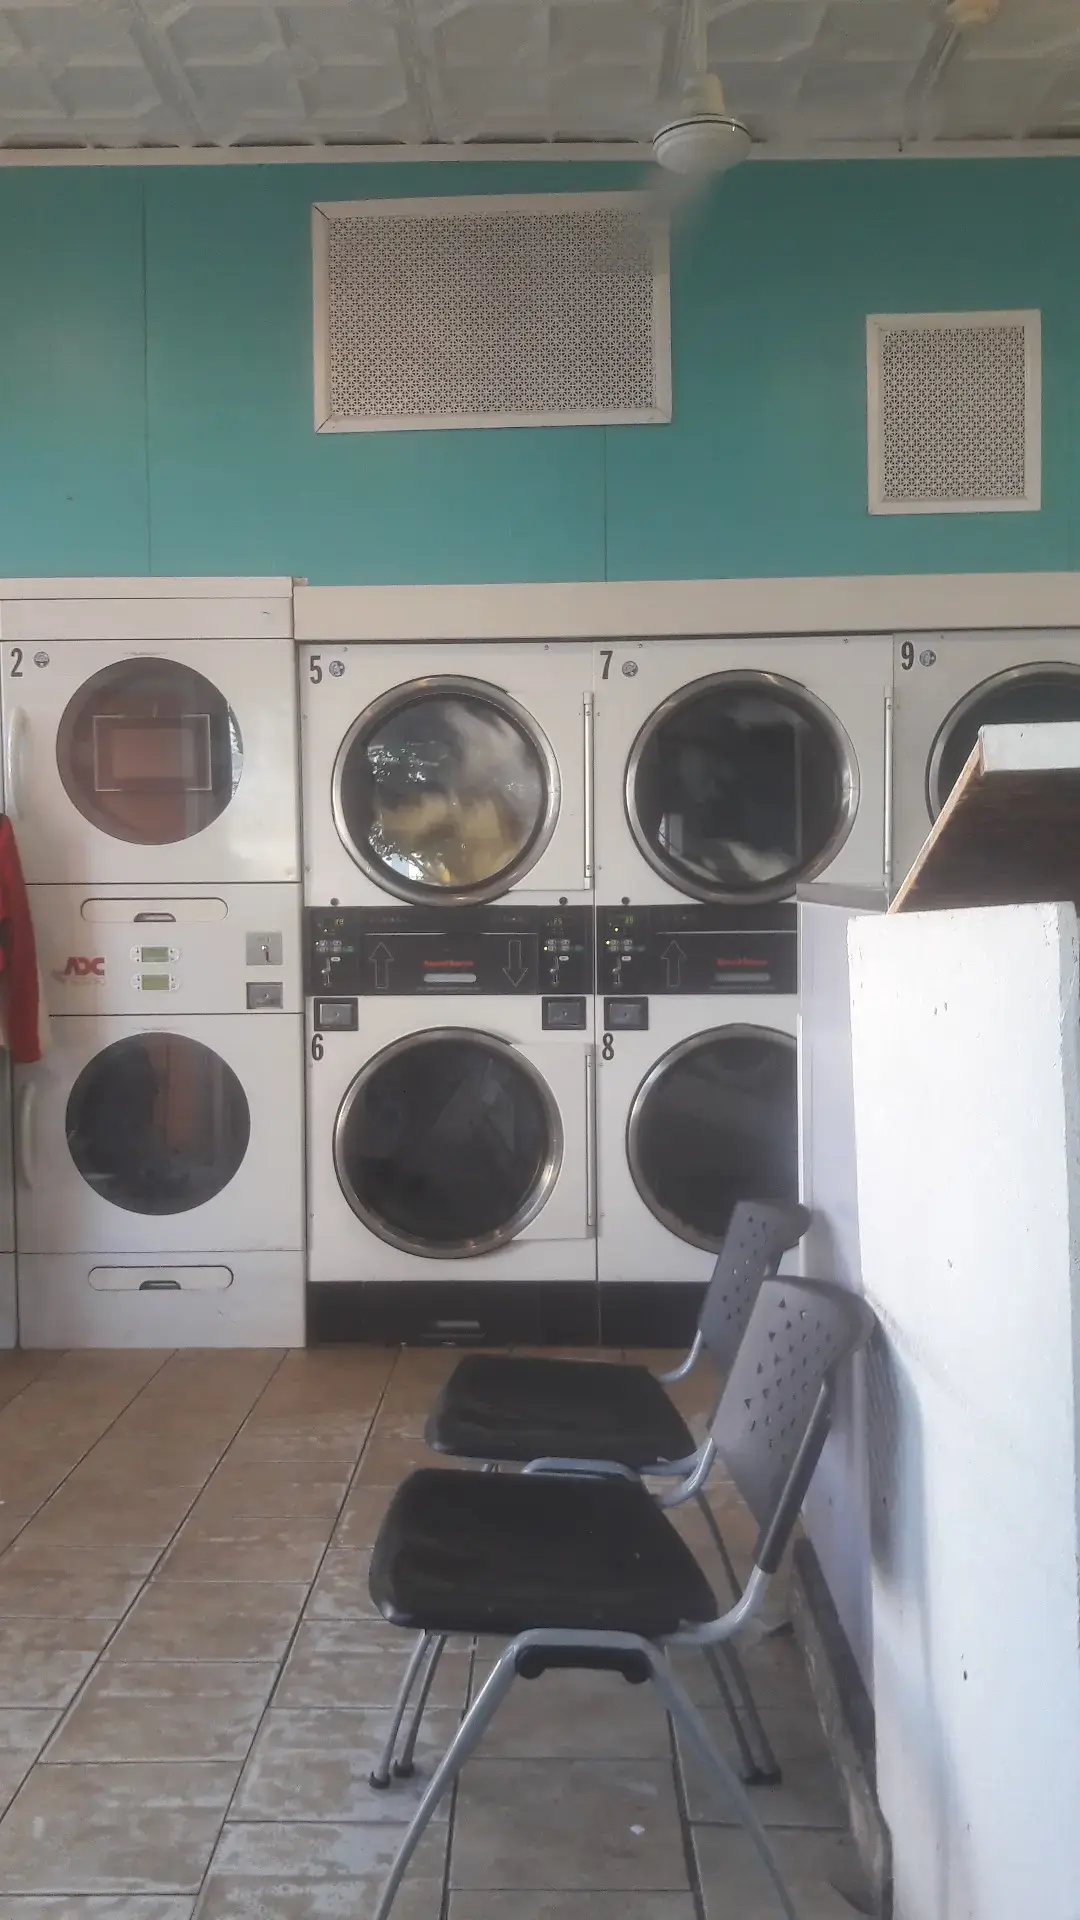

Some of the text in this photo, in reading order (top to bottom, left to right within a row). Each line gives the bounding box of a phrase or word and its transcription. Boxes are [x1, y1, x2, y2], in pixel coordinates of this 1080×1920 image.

[11, 648, 22, 677] 2
[310, 655, 322, 684] 5
[600, 651, 613, 679] 7
[901, 641, 914, 670] 9
[312, 1033, 324, 1061] 6
[602, 1033, 614, 1060] 8
